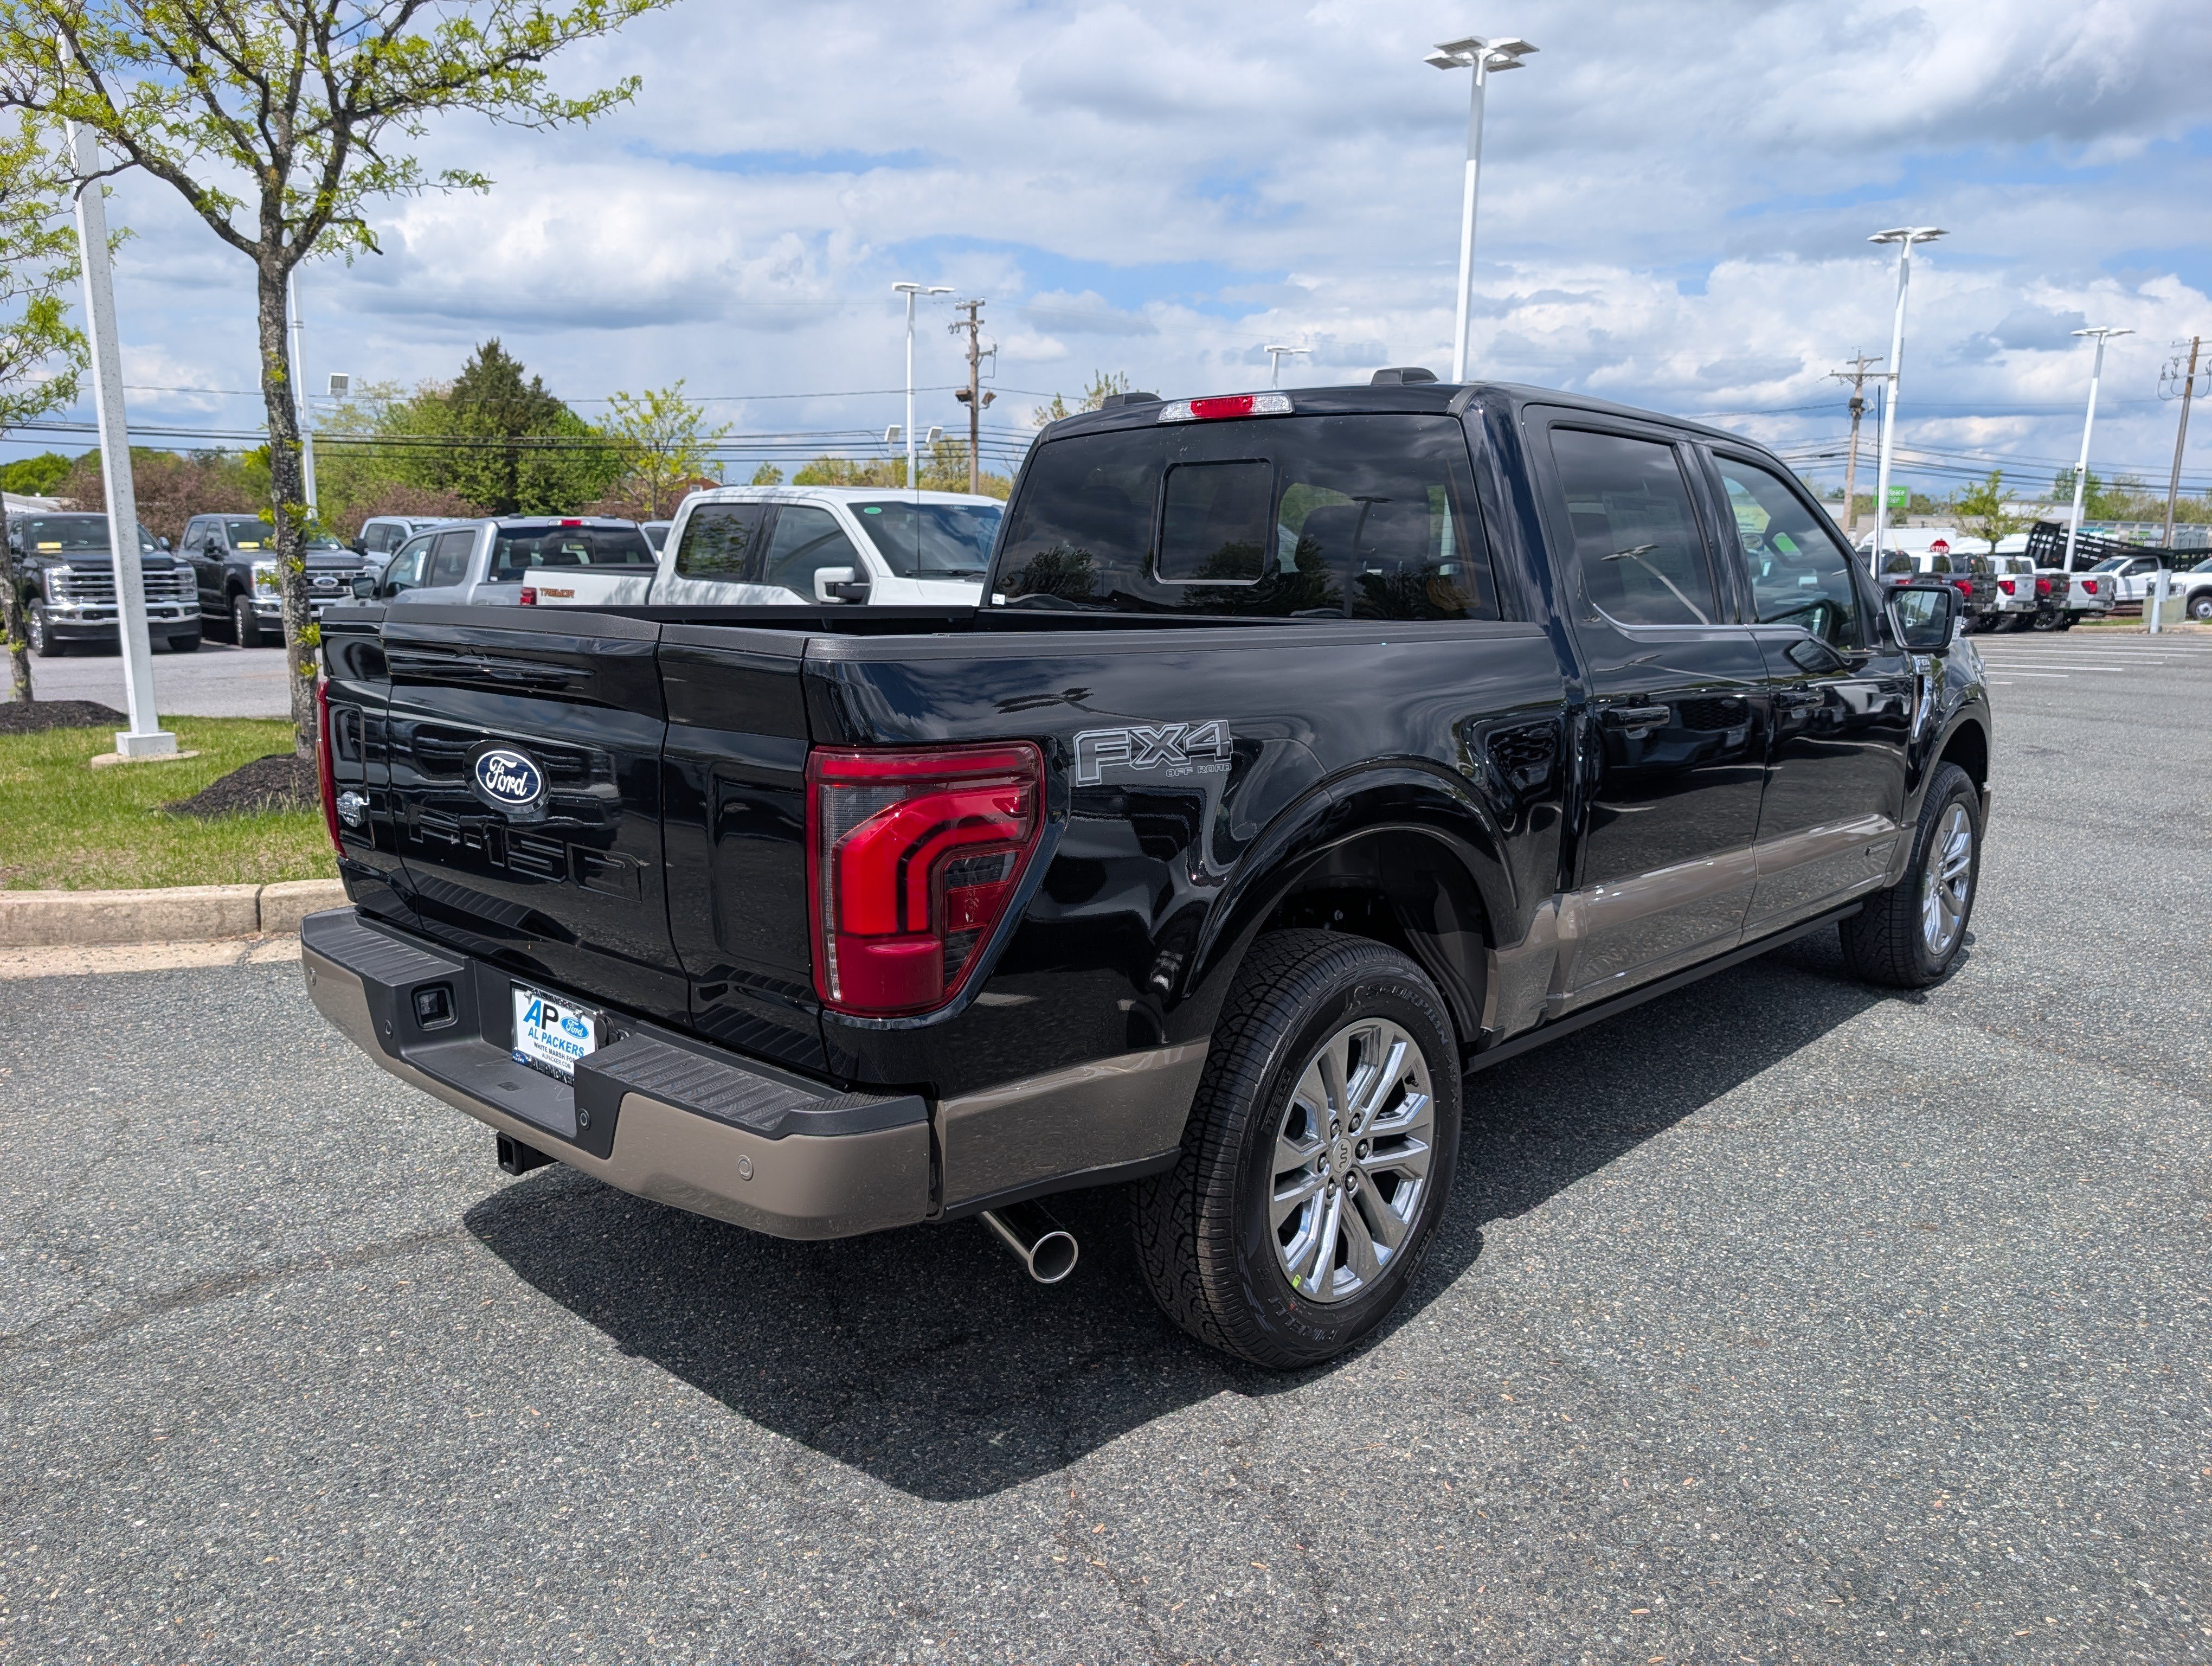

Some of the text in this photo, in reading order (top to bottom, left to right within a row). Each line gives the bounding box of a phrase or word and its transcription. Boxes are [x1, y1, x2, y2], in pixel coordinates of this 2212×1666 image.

[539, 587, 575, 598] TREMOR
[1073, 719, 1233, 787] FX4
[1166, 762, 1232, 778] OFF ROAD
[486, 756, 528, 797] Ford
[407, 804, 642, 904] F-150
[523, 999, 584, 1037] AP Ford
[1366, 982, 1449, 1046] SCORPION
[528, 1026, 539, 1040] AL
[541, 1031, 584, 1058] PACKERS
[533, 1041, 548, 1053] WHITE
[549, 1048, 565, 1060] MARSH
[542, 1053, 571, 1069] ALPACKER.COM
[1268, 1295, 1339, 1342] PIRELLI
